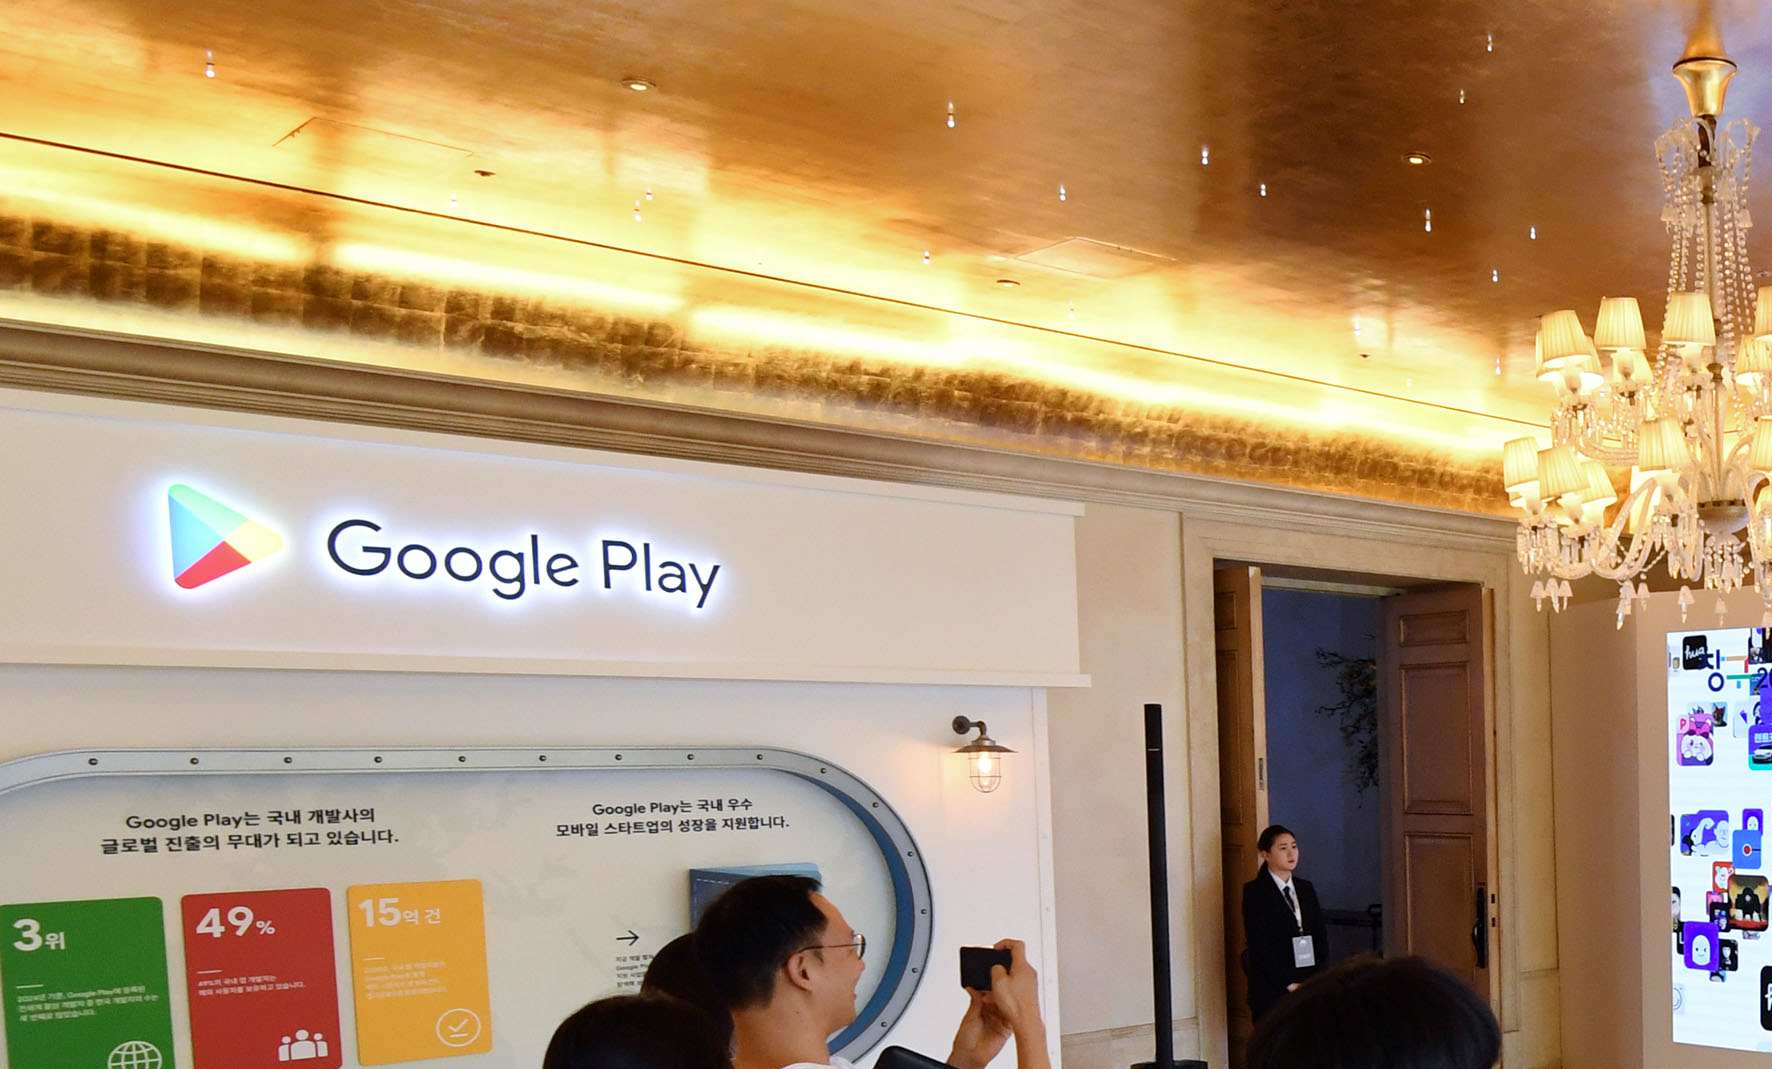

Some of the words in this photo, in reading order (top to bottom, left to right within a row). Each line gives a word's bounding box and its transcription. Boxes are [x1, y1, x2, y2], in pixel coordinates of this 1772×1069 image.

[327, 519, 579, 600] Google
[601, 540, 720, 608] Play
[125, 814, 198, 831] Google
[203, 811, 260, 829] Play는
[267, 809, 301, 824] 국내
[308, 807, 375, 824] 개발사의
[592, 802, 646, 817] Google
[650, 800, 692, 816] Play는
[697, 798, 723, 812] 국내
[727, 798, 753, 811] 우수
[556, 822, 599, 837] 모바일
[603, 820, 673, 835] 스타트업의
[678, 819, 717, 833] 성장을
[722, 815, 790, 830] 지원합니다.
[100, 837, 159, 855] 글로벌
[165, 834, 220, 852] 진출의
[226, 834, 280, 849] 무대가
[286, 832, 321, 847] 되고
[326, 829, 399, 846] 있습니다.
[196, 906, 276, 938] 49%
[358, 897, 419, 928] 15억
[423, 906, 441, 925] 건
[13, 918, 65, 951] 3위
